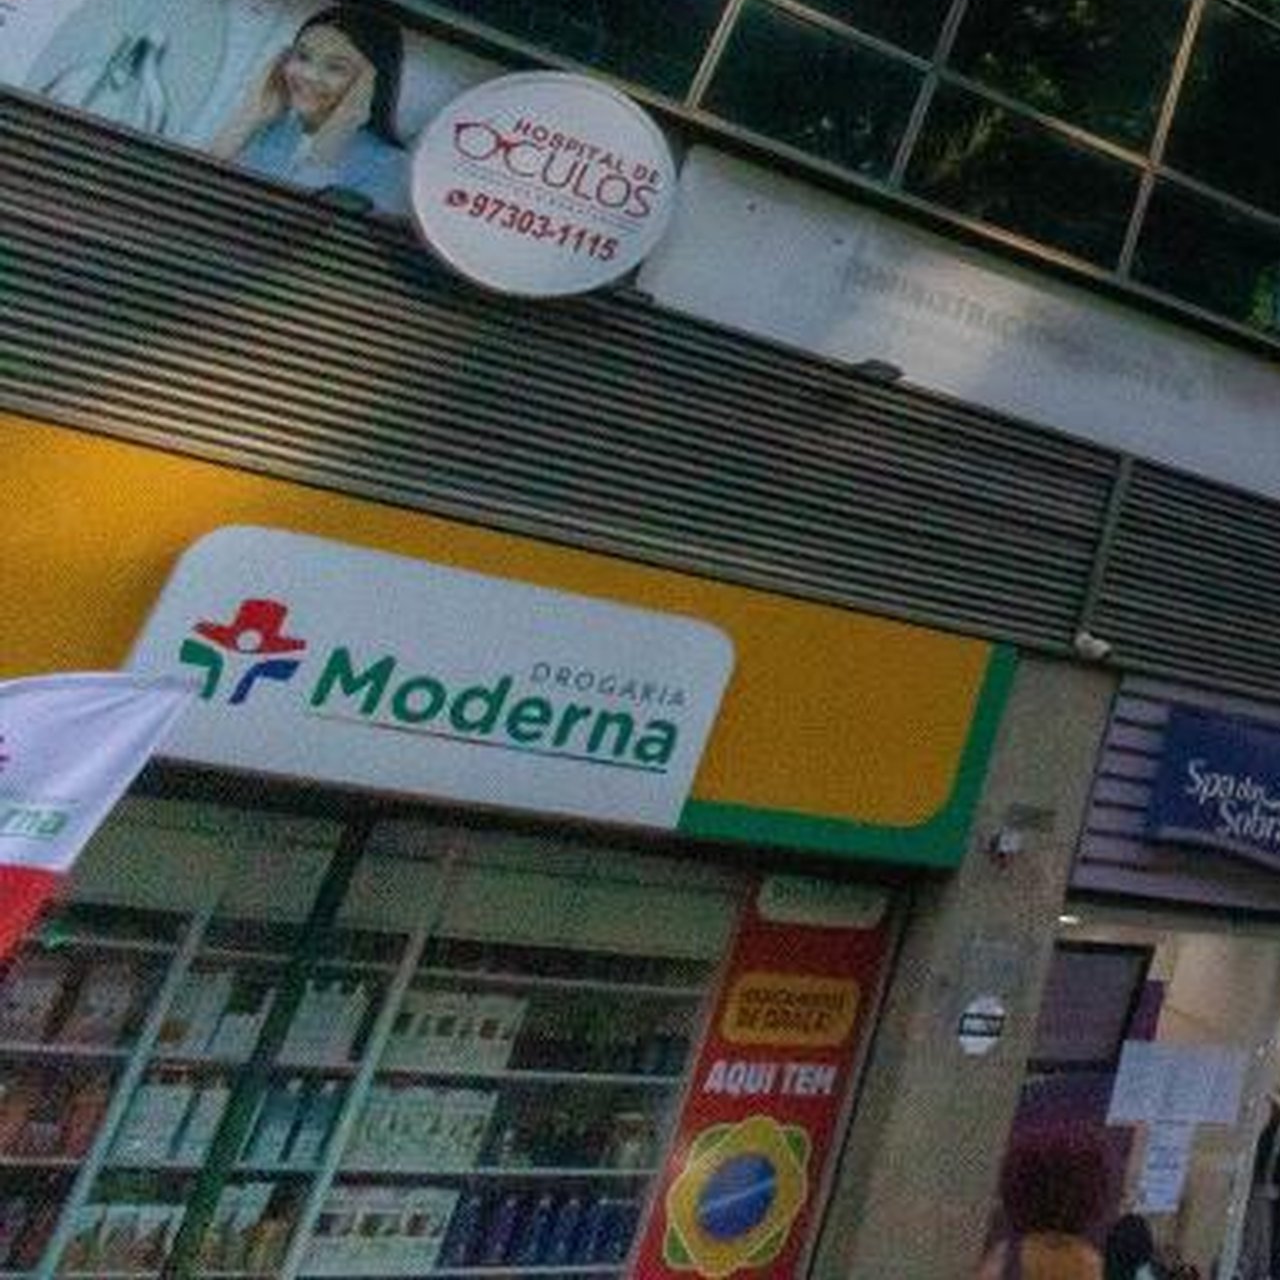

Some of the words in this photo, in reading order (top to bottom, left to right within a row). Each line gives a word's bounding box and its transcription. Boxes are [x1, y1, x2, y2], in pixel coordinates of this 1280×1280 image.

[512, 117, 626, 172] HOSPITAL
[632, 165, 662, 184] DE
[468, 192, 620, 262] 97303-1115
[310, 646, 679, 766] Moderna
[530, 662, 692, 708] DROGARIA
[1186, 757, 1235, 805] Spa
[702, 1059, 776, 1095] AQUI
[780, 1062, 838, 1096] TEM
